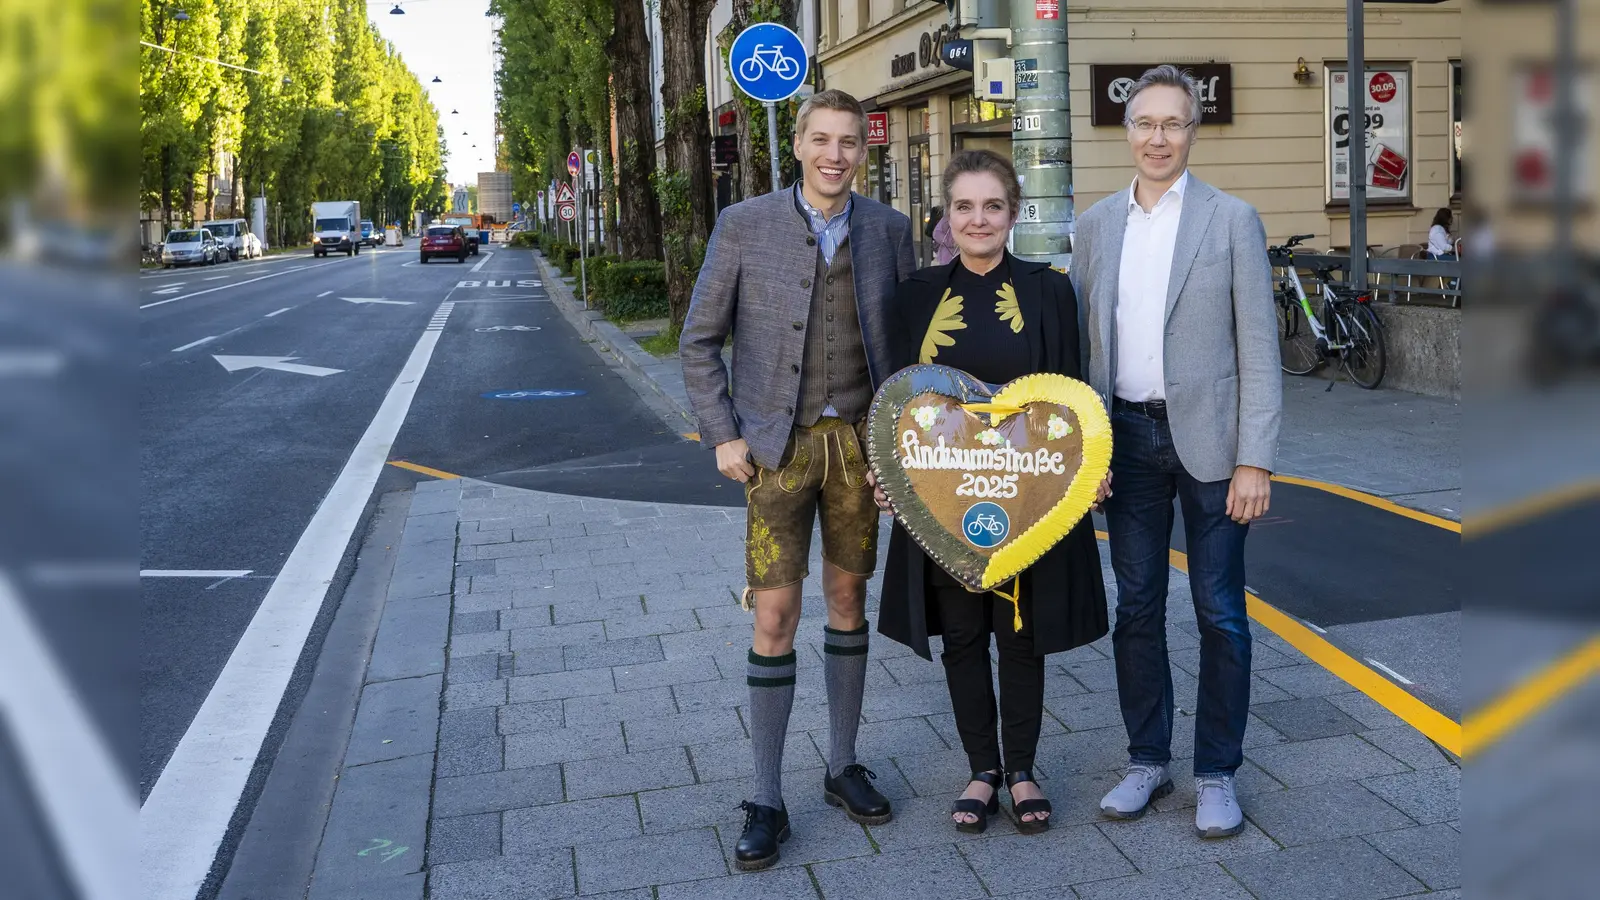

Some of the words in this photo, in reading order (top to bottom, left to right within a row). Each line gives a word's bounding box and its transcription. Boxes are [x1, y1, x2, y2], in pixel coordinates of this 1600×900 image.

[949, 46, 967, 59] 064
[1370, 82, 1396, 93] 30.09.
[869, 120, 883, 128] TE
[868, 129, 884, 137] AB
[562, 208, 573, 217] 30
[455, 279, 543, 288] BUS
[955, 473, 1019, 498] 2025
